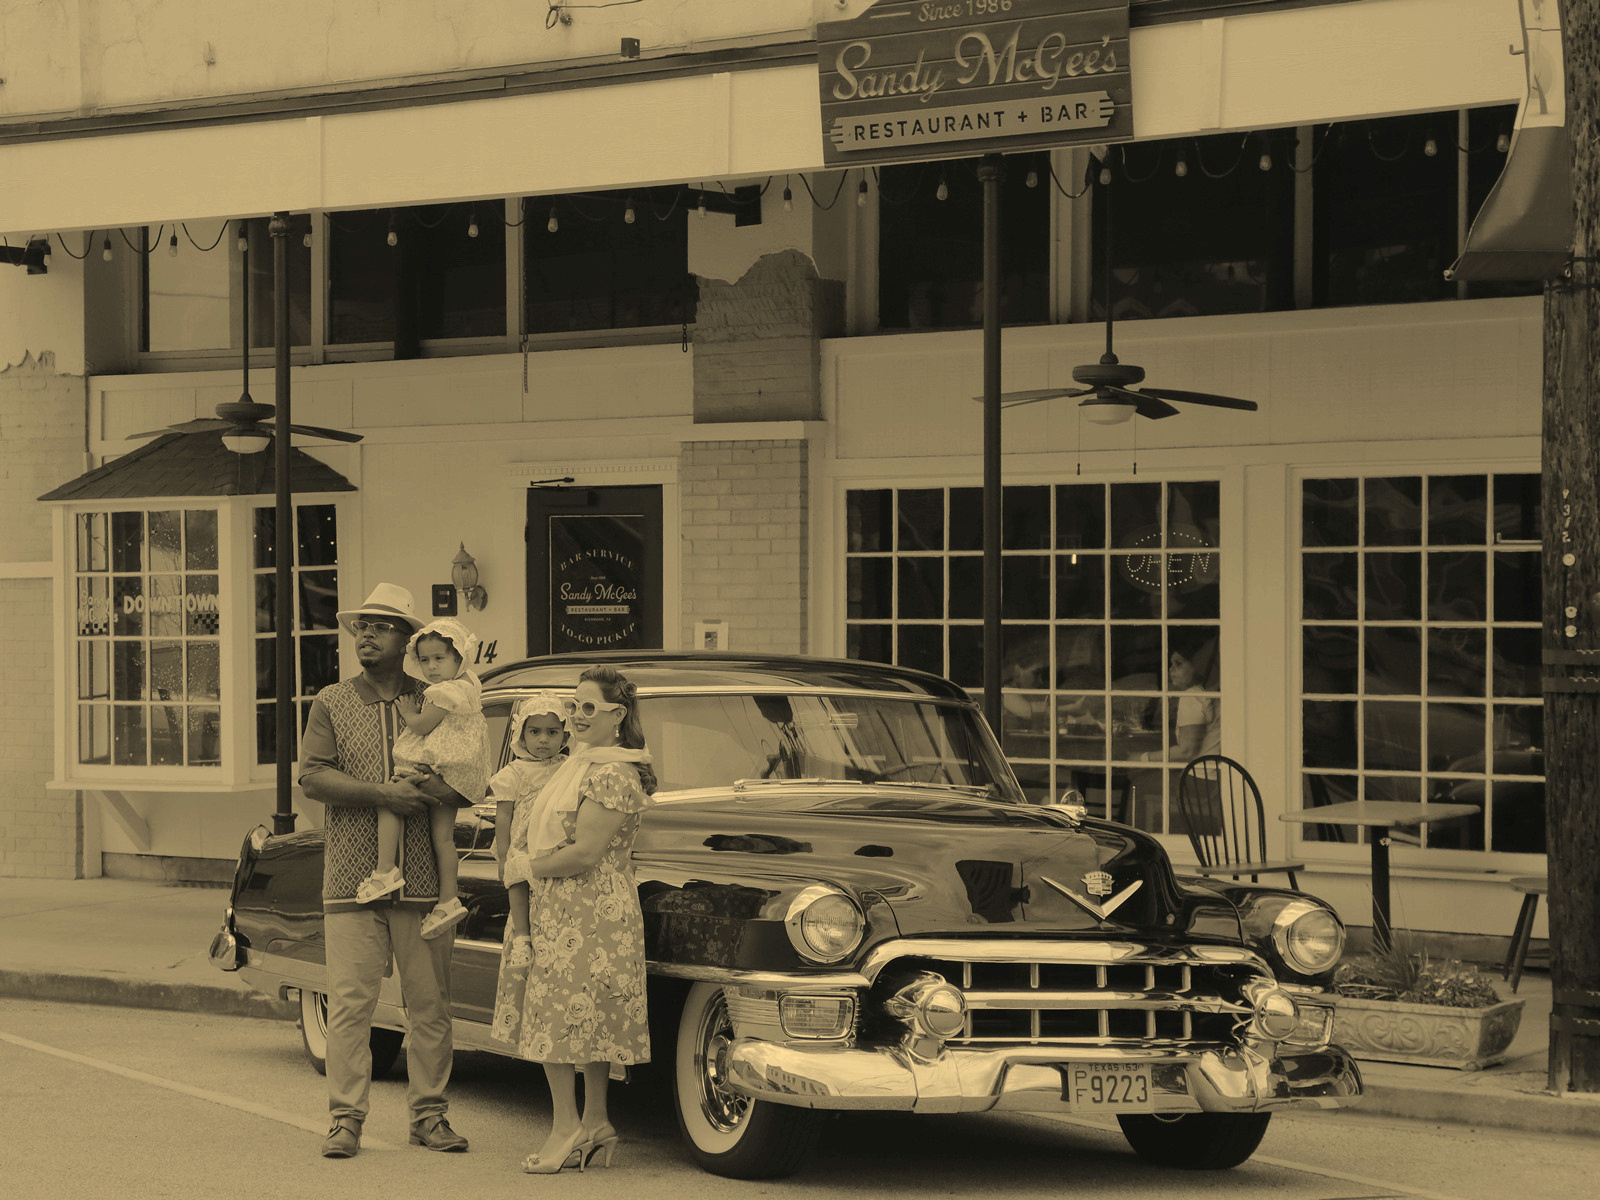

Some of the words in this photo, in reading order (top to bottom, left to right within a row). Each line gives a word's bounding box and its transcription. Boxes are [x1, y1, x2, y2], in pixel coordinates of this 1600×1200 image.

[918, 3, 963, 22] Since
[966, 0, 1013, 16] 1986
[832, 41, 945, 103] Sandy
[954, 22, 1117, 90] McGee's
[854, 111, 1005, 141] RESTAURANT
[1017, 110, 1028, 123] +
[1041, 102, 1089, 123] BAR
[560, 553, 582, 571] BAR
[586, 549, 634, 569] SERVICE
[560, 582, 593, 603] Sandy
[594, 583, 637, 603] McGee's
[123, 593, 219, 615] DOWNTOWN
[560, 623, 593, 645] TO-GO
[597, 622, 636, 645] PICKUP
[1089, 1063, 1119, 1071] TEXAS
[1091, 1074, 1148, 1104] 9223
